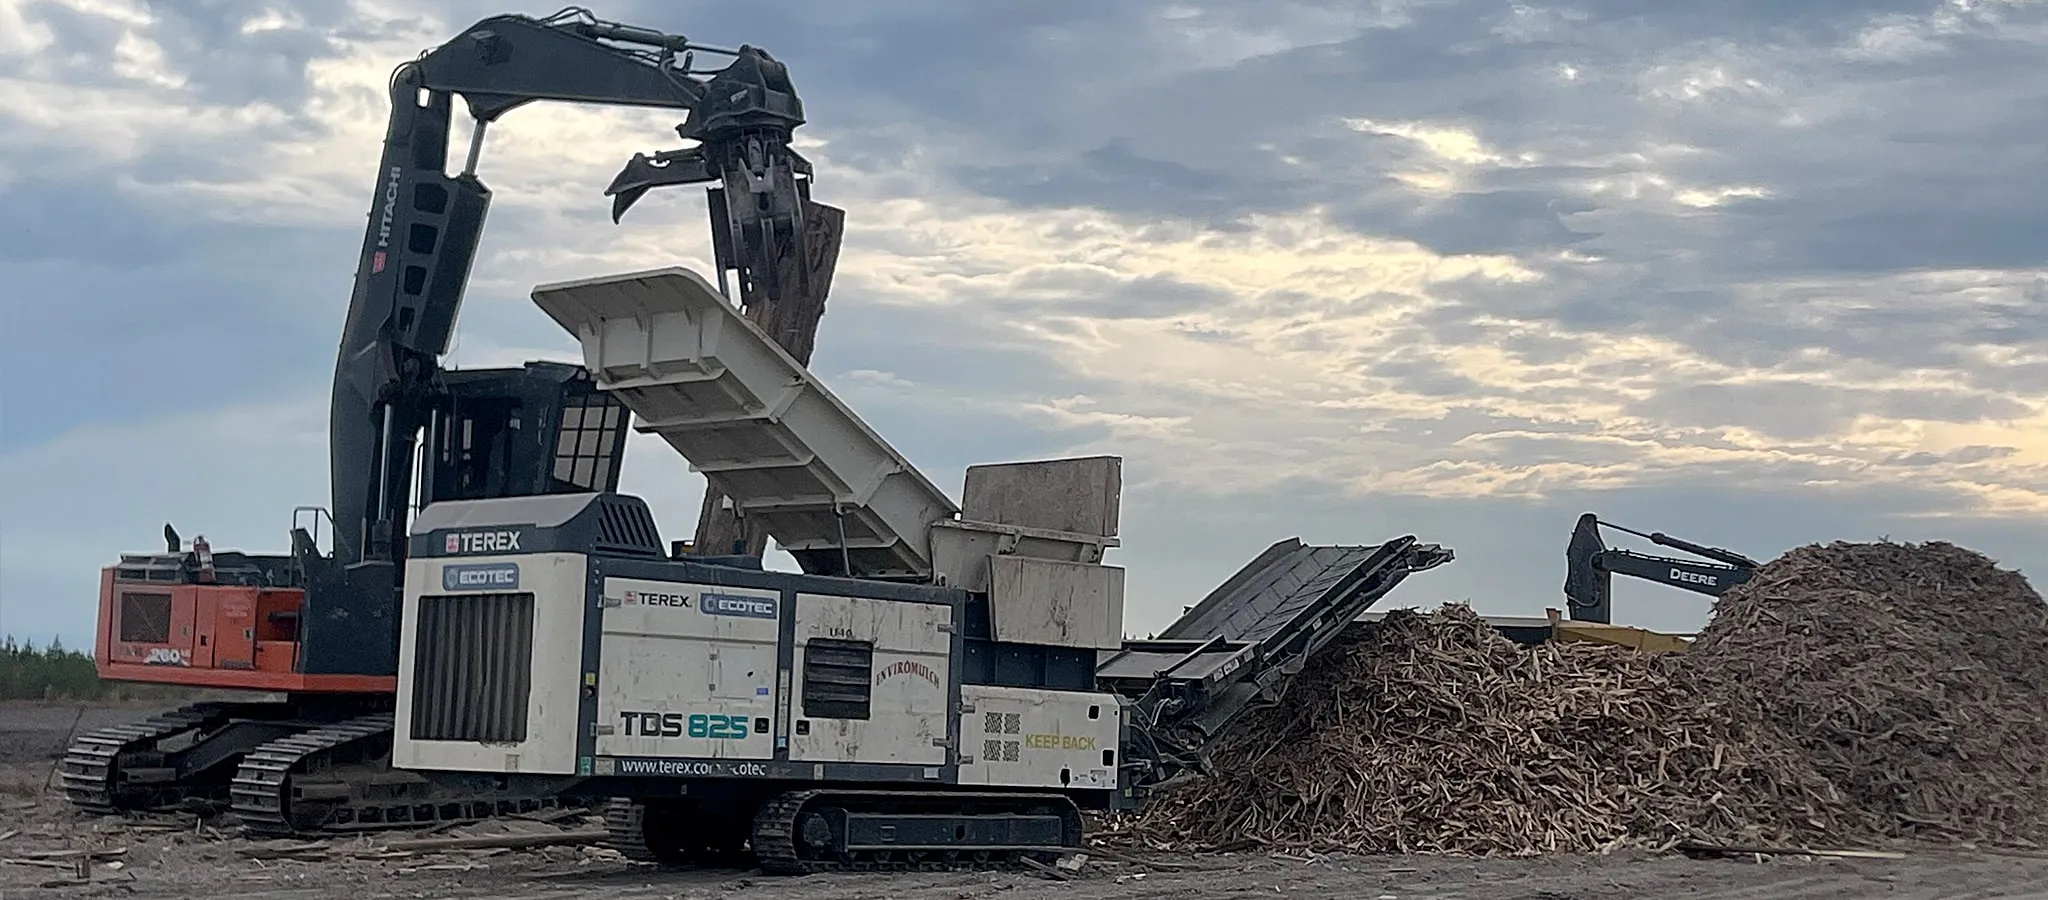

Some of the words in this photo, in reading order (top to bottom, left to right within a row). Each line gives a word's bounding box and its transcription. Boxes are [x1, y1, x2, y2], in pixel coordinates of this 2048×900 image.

[378, 167, 401, 248] HITACHI
[461, 531, 520, 552] TEREX
[460, 569, 514, 584] ECOTEC
[1670, 568, 1718, 586] DEERE
[638, 592, 689, 607] TEREX
[718, 599, 773, 614] ECOTEC
[620, 711, 683, 737] TDS
[688, 714, 748, 739] 825
[1025, 734, 1059, 749] KEEP
[1062, 736, 1096, 751] BACK
[622, 760, 767, 776] www.terex.cocotec
